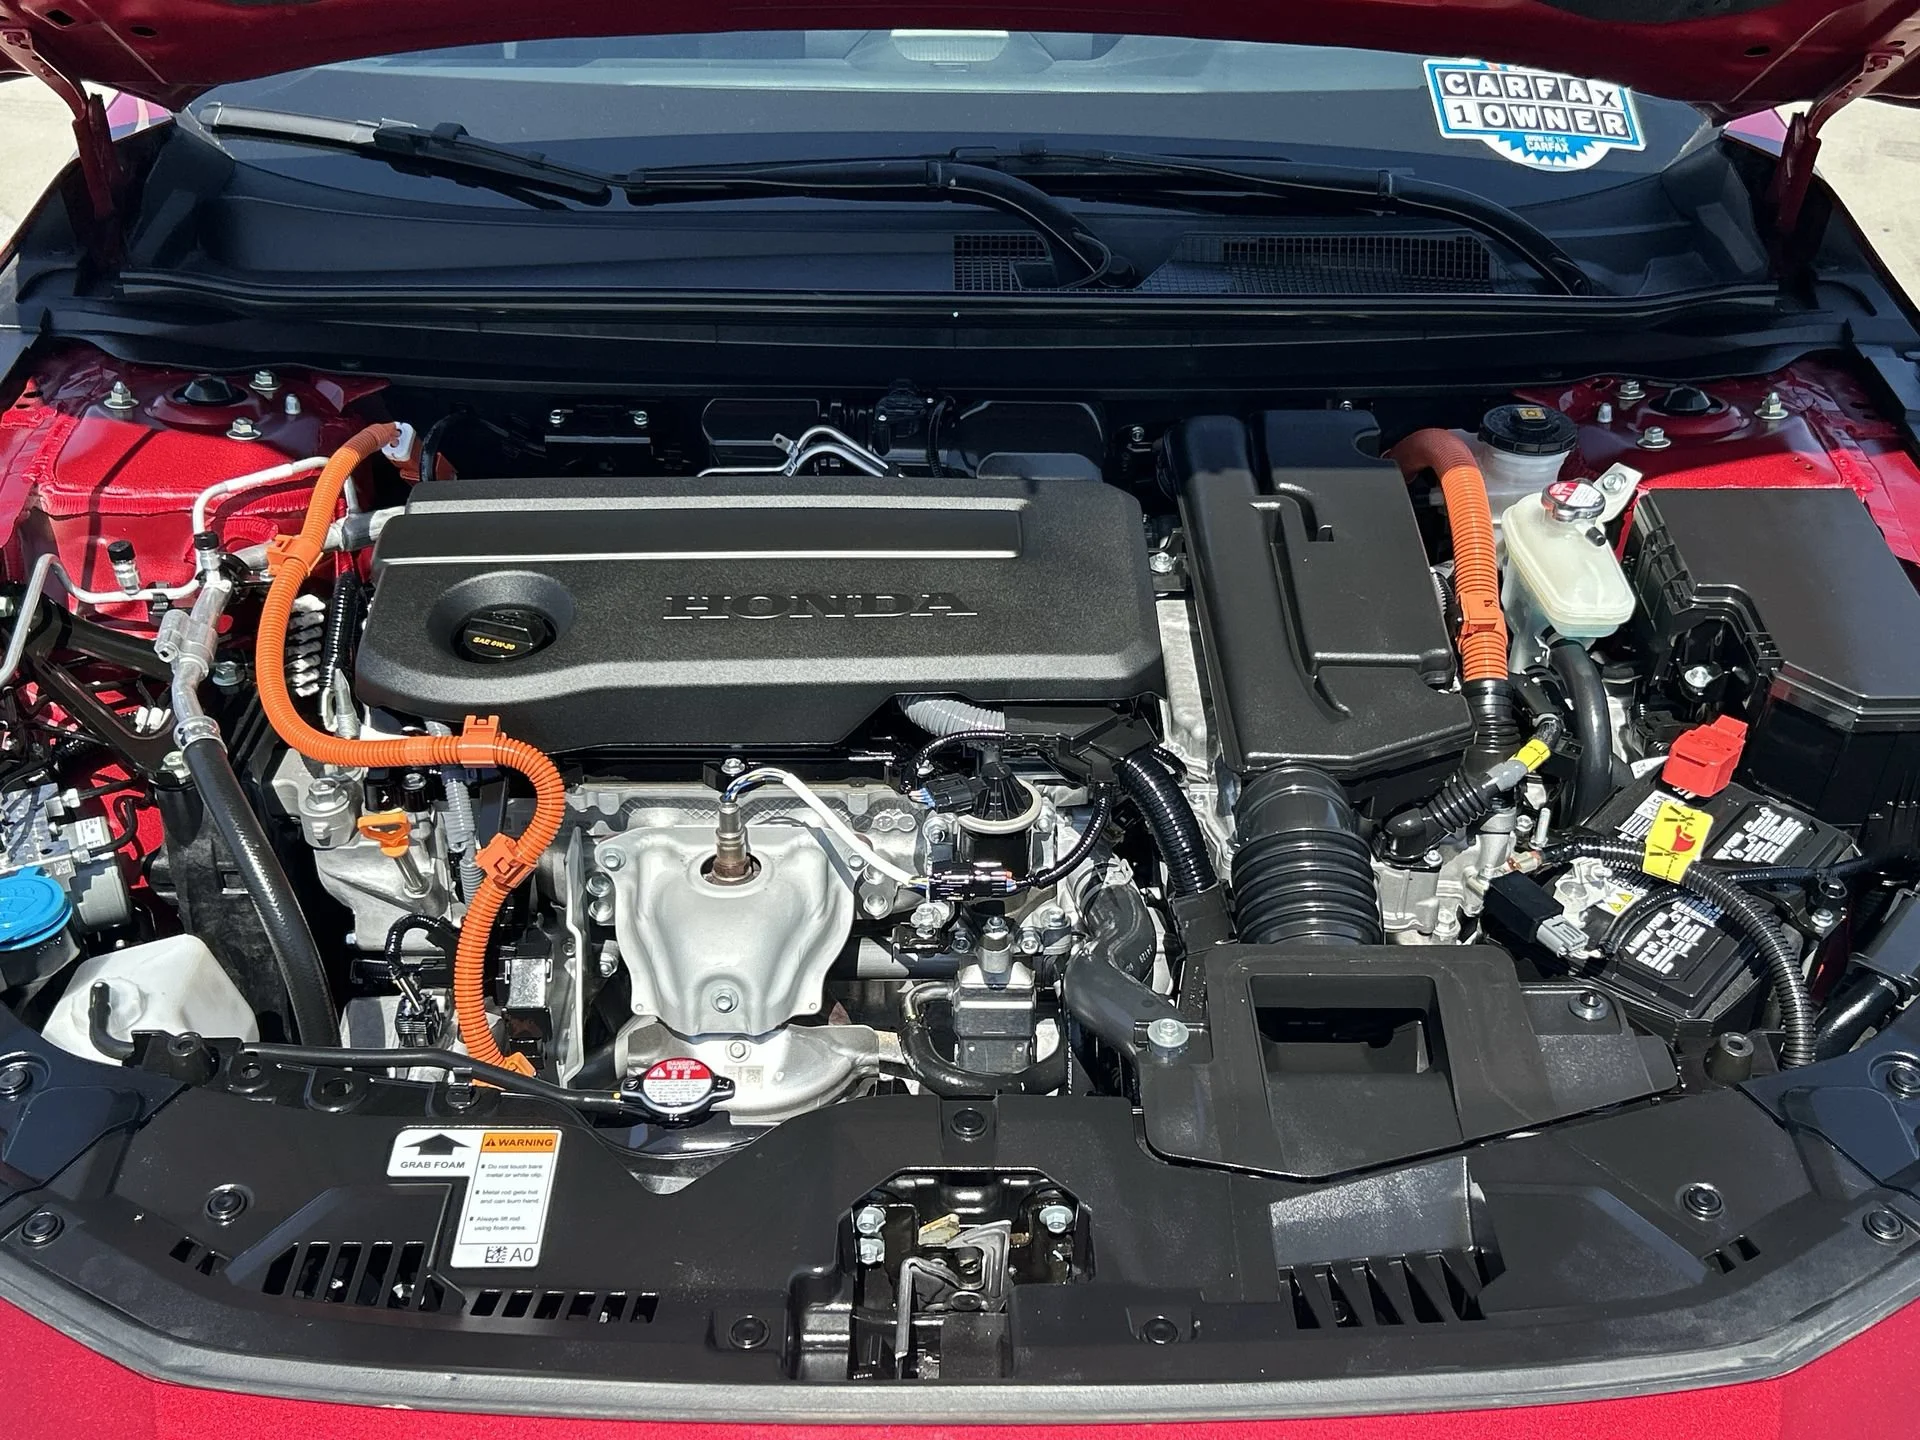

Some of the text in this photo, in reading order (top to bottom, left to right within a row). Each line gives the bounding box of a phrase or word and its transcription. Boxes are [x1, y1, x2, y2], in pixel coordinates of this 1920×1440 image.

[1444, 72, 1618, 108] CARFAX
[1482, 103, 1626, 136] OWNER
[1526, 141, 1570, 153] CARFAX
[663, 592, 978, 621] HONDA
[472, 636, 491, 646] SAE
[498, 1138, 553, 1147] WARNING
[400, 1161, 465, 1169] GRAB FOAM
[509, 1247, 534, 1262] A0
